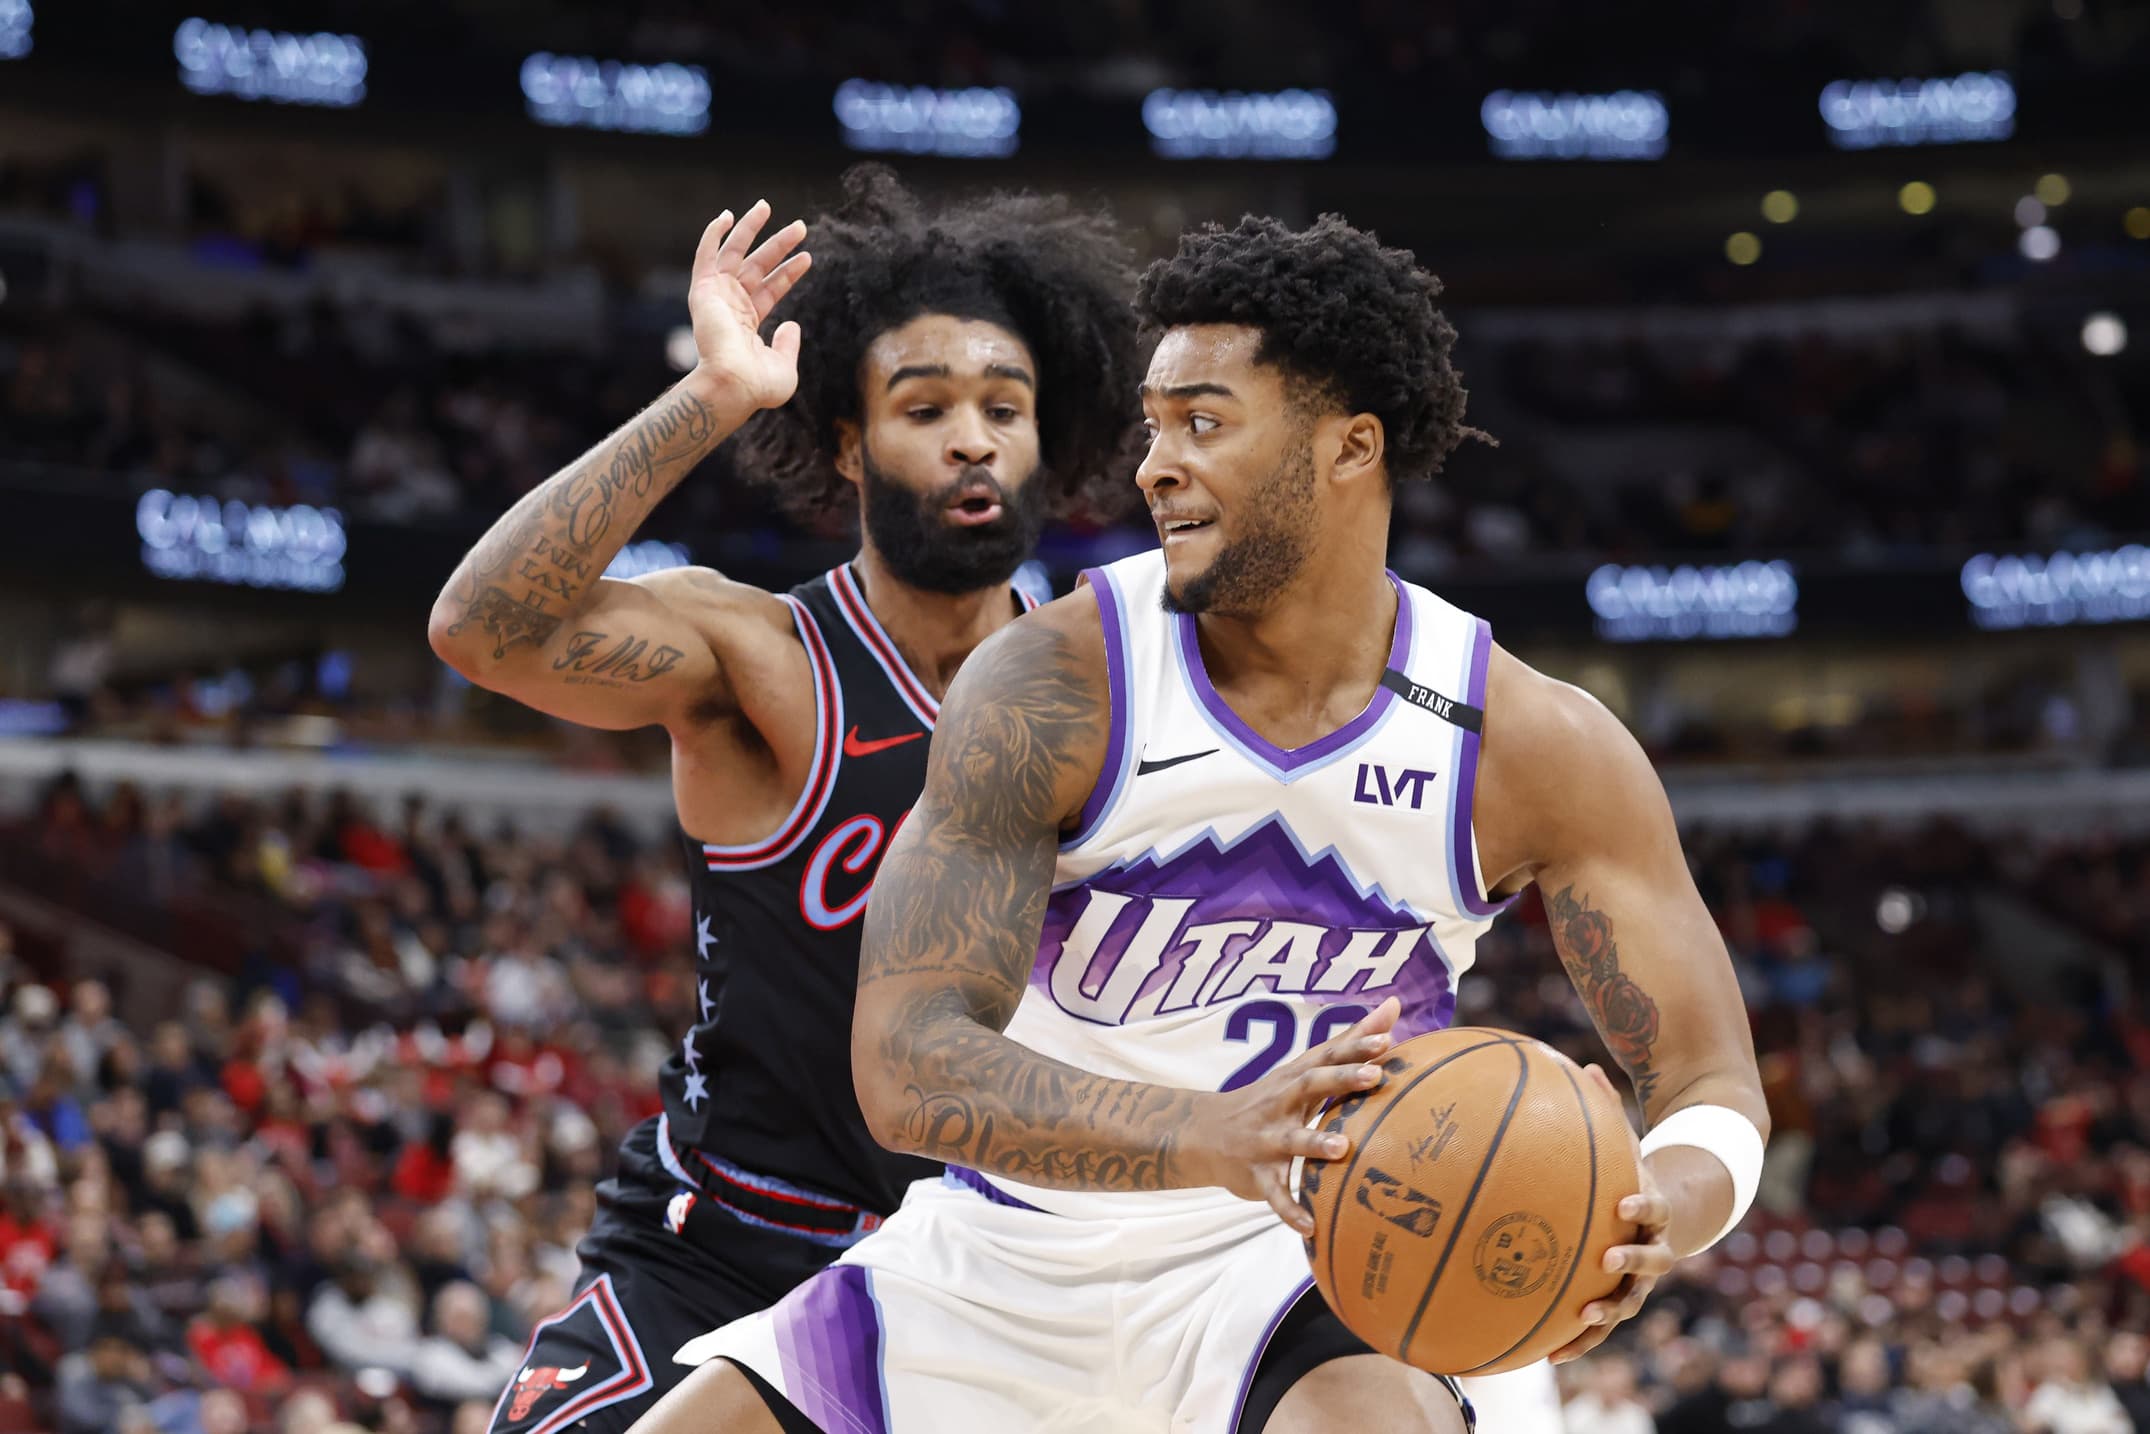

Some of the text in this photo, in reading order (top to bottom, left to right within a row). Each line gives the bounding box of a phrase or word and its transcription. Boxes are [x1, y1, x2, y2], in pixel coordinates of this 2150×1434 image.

[1407, 684, 1454, 719] FRANK
[1353, 763, 1438, 810] LVT
[1049, 884, 1435, 1027] UTAH
